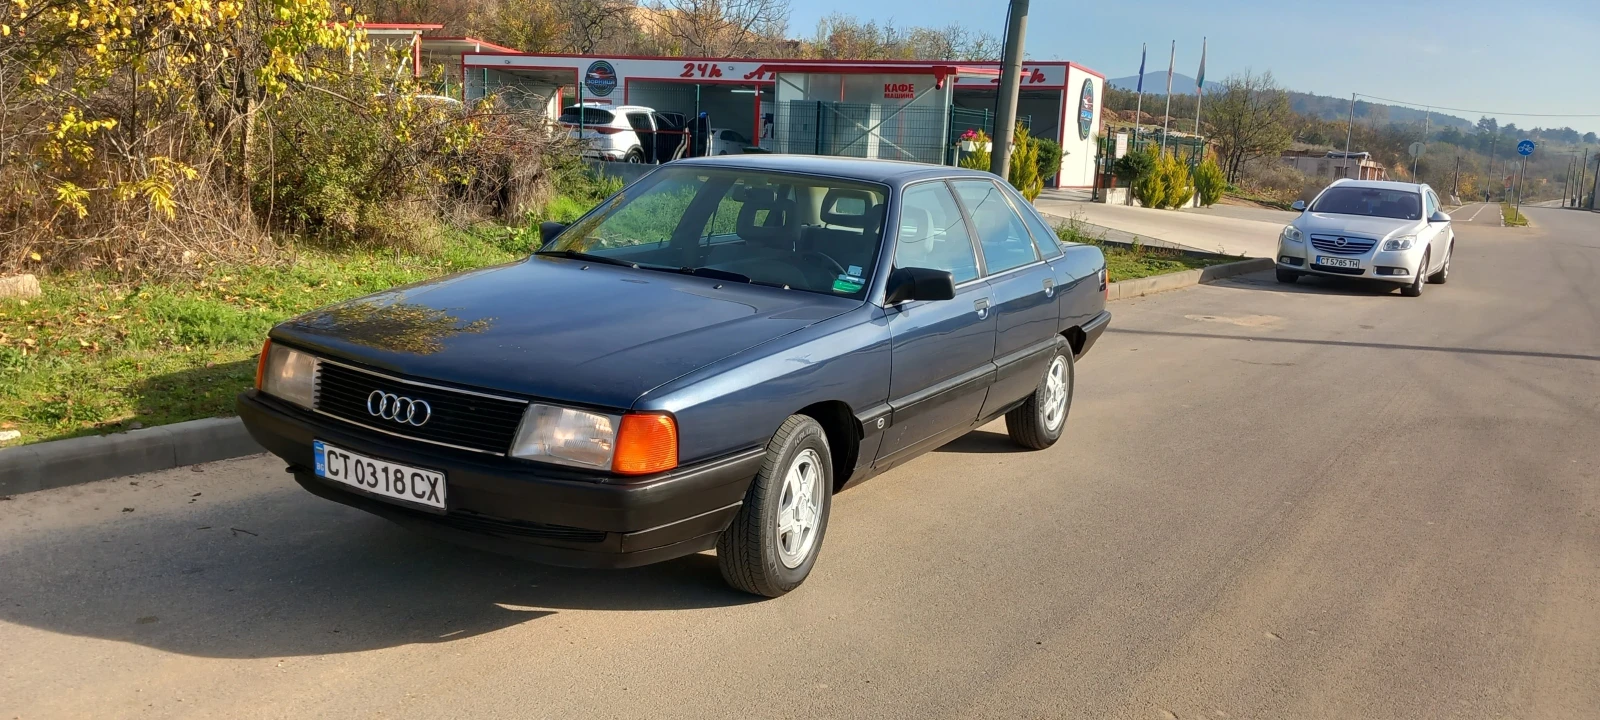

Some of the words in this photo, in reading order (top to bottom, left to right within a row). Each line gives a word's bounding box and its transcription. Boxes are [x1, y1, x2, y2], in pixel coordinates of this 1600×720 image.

[680, 63, 722, 78] 24h
[884, 83, 915, 93] КАФЕ
[1330, 258, 1347, 267] 5785
[316, 462, 325, 472] BG
[326, 449, 351, 480] CT
[354, 458, 406, 495] 0318
[410, 471, 441, 504] CX
